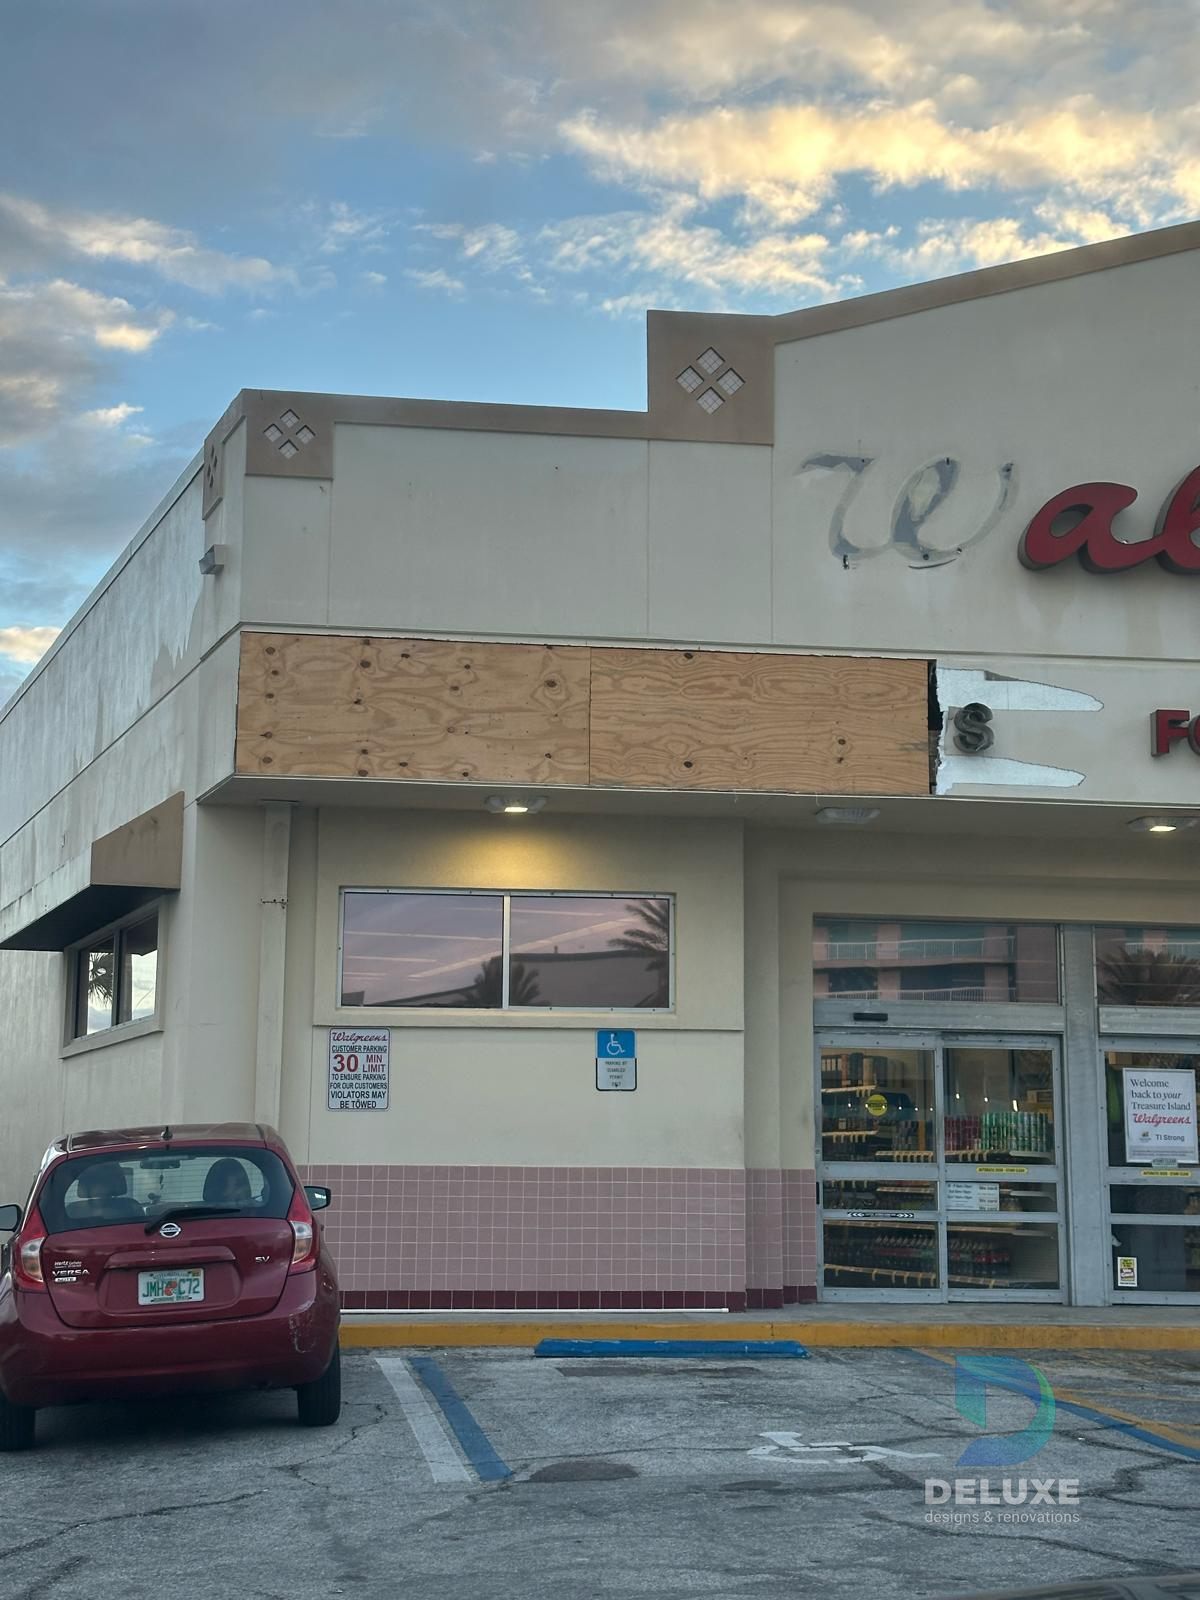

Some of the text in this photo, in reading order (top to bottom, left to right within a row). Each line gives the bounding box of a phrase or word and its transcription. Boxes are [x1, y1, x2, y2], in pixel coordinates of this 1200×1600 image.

[1150, 708, 1200, 757] F
[332, 1031, 387, 1044] Walgreens
[332, 1045, 387, 1053] CUSTOMER PARKING
[333, 1054, 383, 1073] 30 MIN
[362, 1064, 386, 1073] LIMIT
[1130, 1079, 1169, 1087] Welcome
[330, 1090, 387, 1099] VIOLATORS MAY
[1131, 1089, 1182, 1101] back to your
[340, 1100, 377, 1109] BE TOWED
[1131, 1102, 1191, 1111] Treasure Island
[1133, 1113, 1192, 1127] Walgreens
[1163, 1134, 1185, 1142] Strong
[255, 1255, 270, 1263] SV
